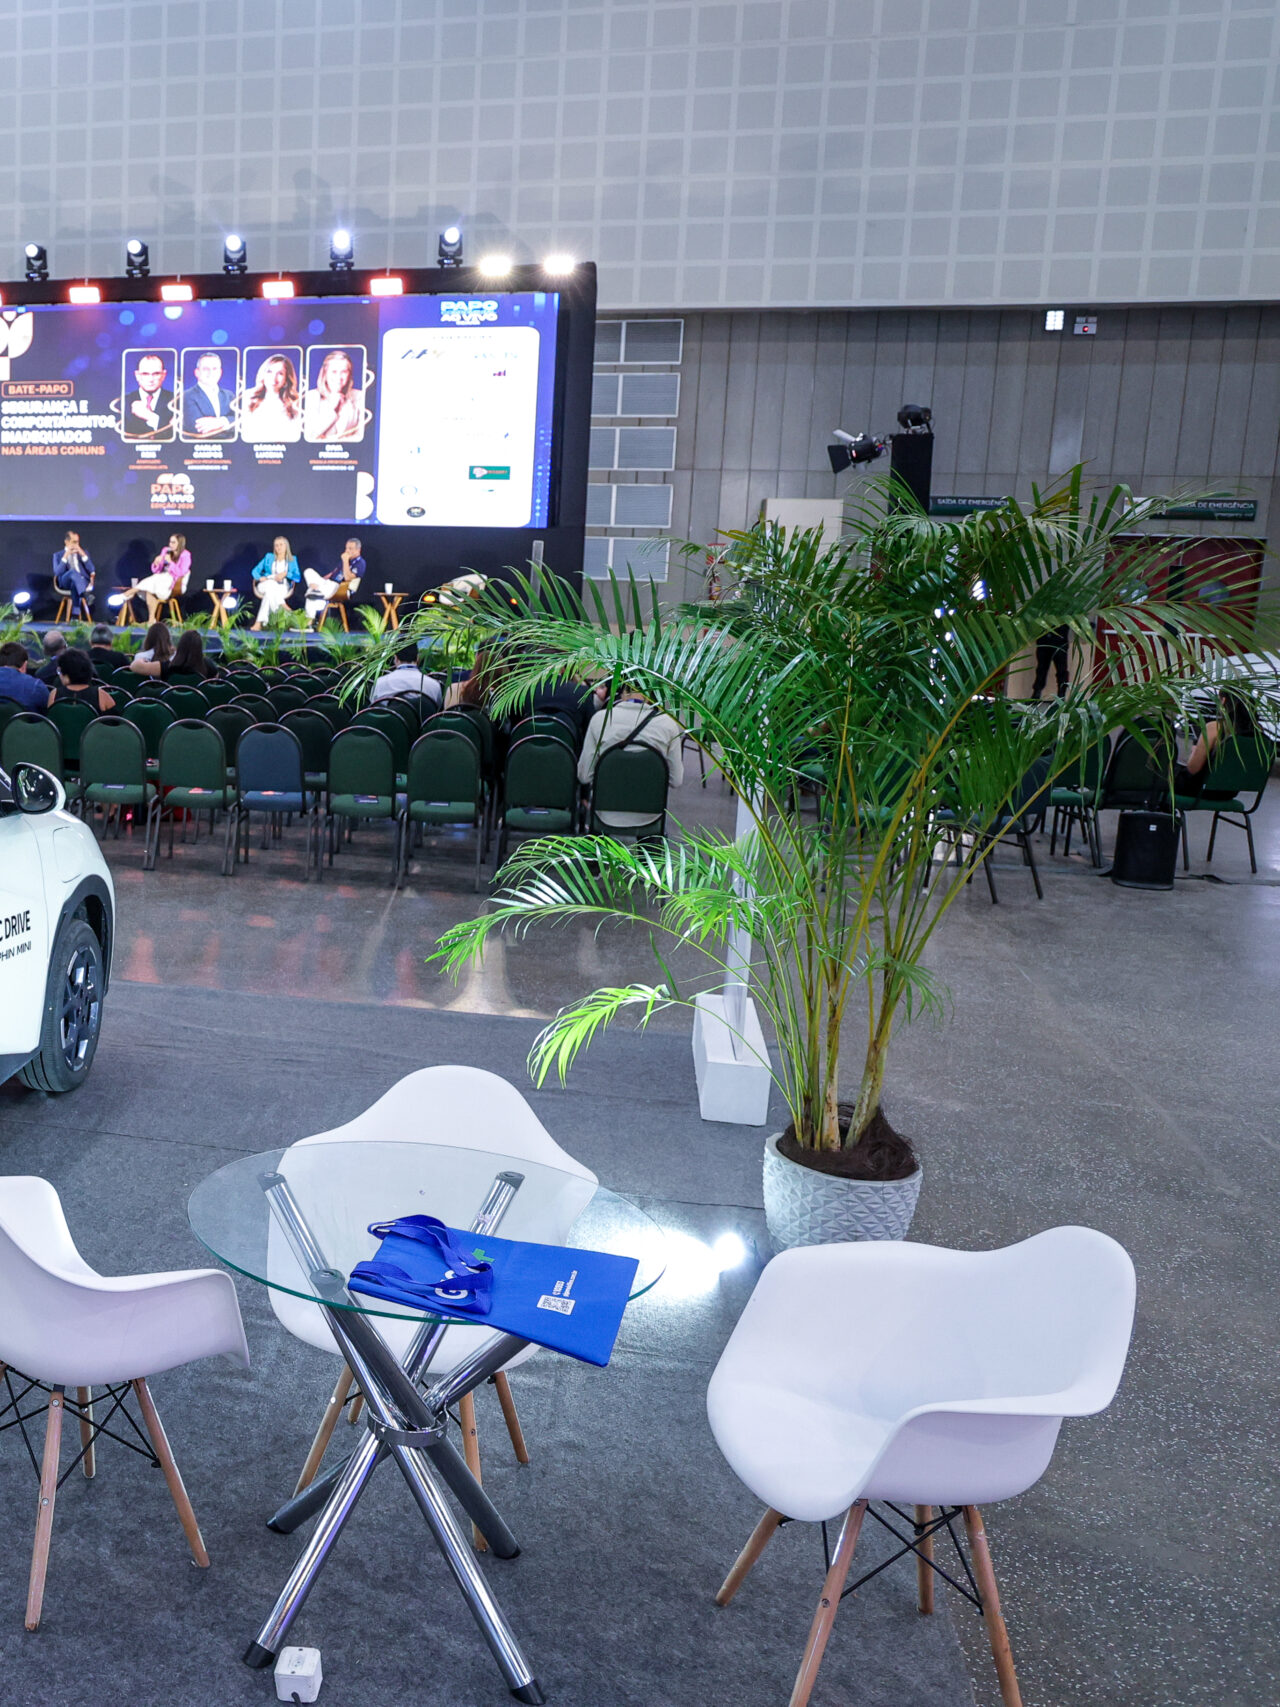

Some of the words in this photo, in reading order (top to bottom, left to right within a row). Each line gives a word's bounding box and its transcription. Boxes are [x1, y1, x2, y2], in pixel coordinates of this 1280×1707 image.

[441, 300, 498, 312] PAPO
[8, 384, 69, 394] BATE-PAPO
[1, 400, 78, 416] SEGURANÇA
[79, 400, 89, 413] E
[1, 415, 116, 429] COMPORTAMENTOS
[1, 430, 92, 444] INADEQUADOS
[1, 446, 23, 455] NAS
[25, 444, 58, 455] ÁREAS
[60, 446, 106, 455] COMUNS
[150, 484, 195, 495] PAPO
[150, 494, 168, 503] AO
[168, 494, 195, 503] VIVO
[968, 498, 1010, 506] EMERGÊNCI
[4, 909, 31, 940] DRIVE
[16, 940, 32, 955] MINI
